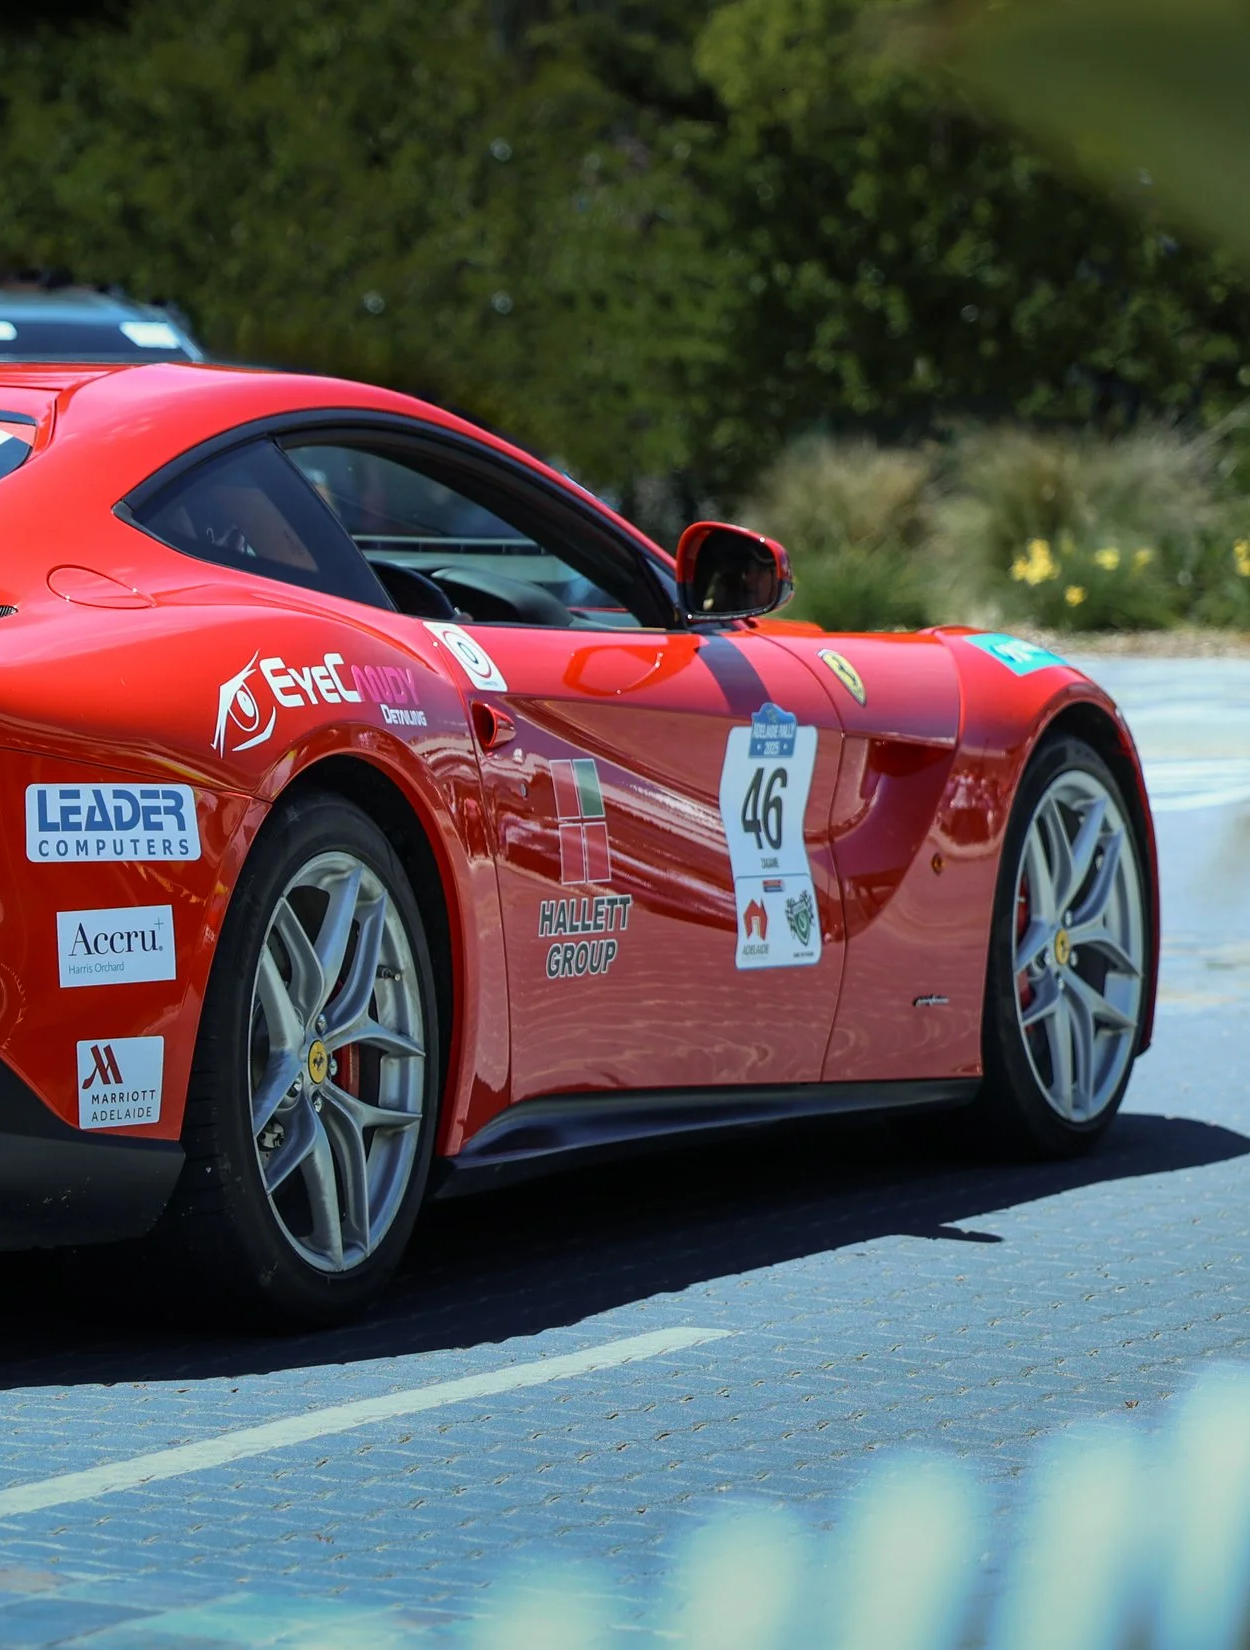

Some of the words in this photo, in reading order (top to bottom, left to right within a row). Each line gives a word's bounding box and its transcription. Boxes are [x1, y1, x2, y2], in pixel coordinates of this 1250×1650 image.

[37, 789, 187, 832] LEADER
[741, 767, 788, 850] 46
[38, 838, 189, 857] COMPUTERS
[538, 894, 632, 937] HALLETT
[68, 963, 93, 975] Harris
[94, 961, 125, 973] Orchard
[546, 938, 618, 979] GROUP
[91, 1089, 156, 1105] MARRIOTT
[91, 1106, 152, 1122] ADELAIDE
